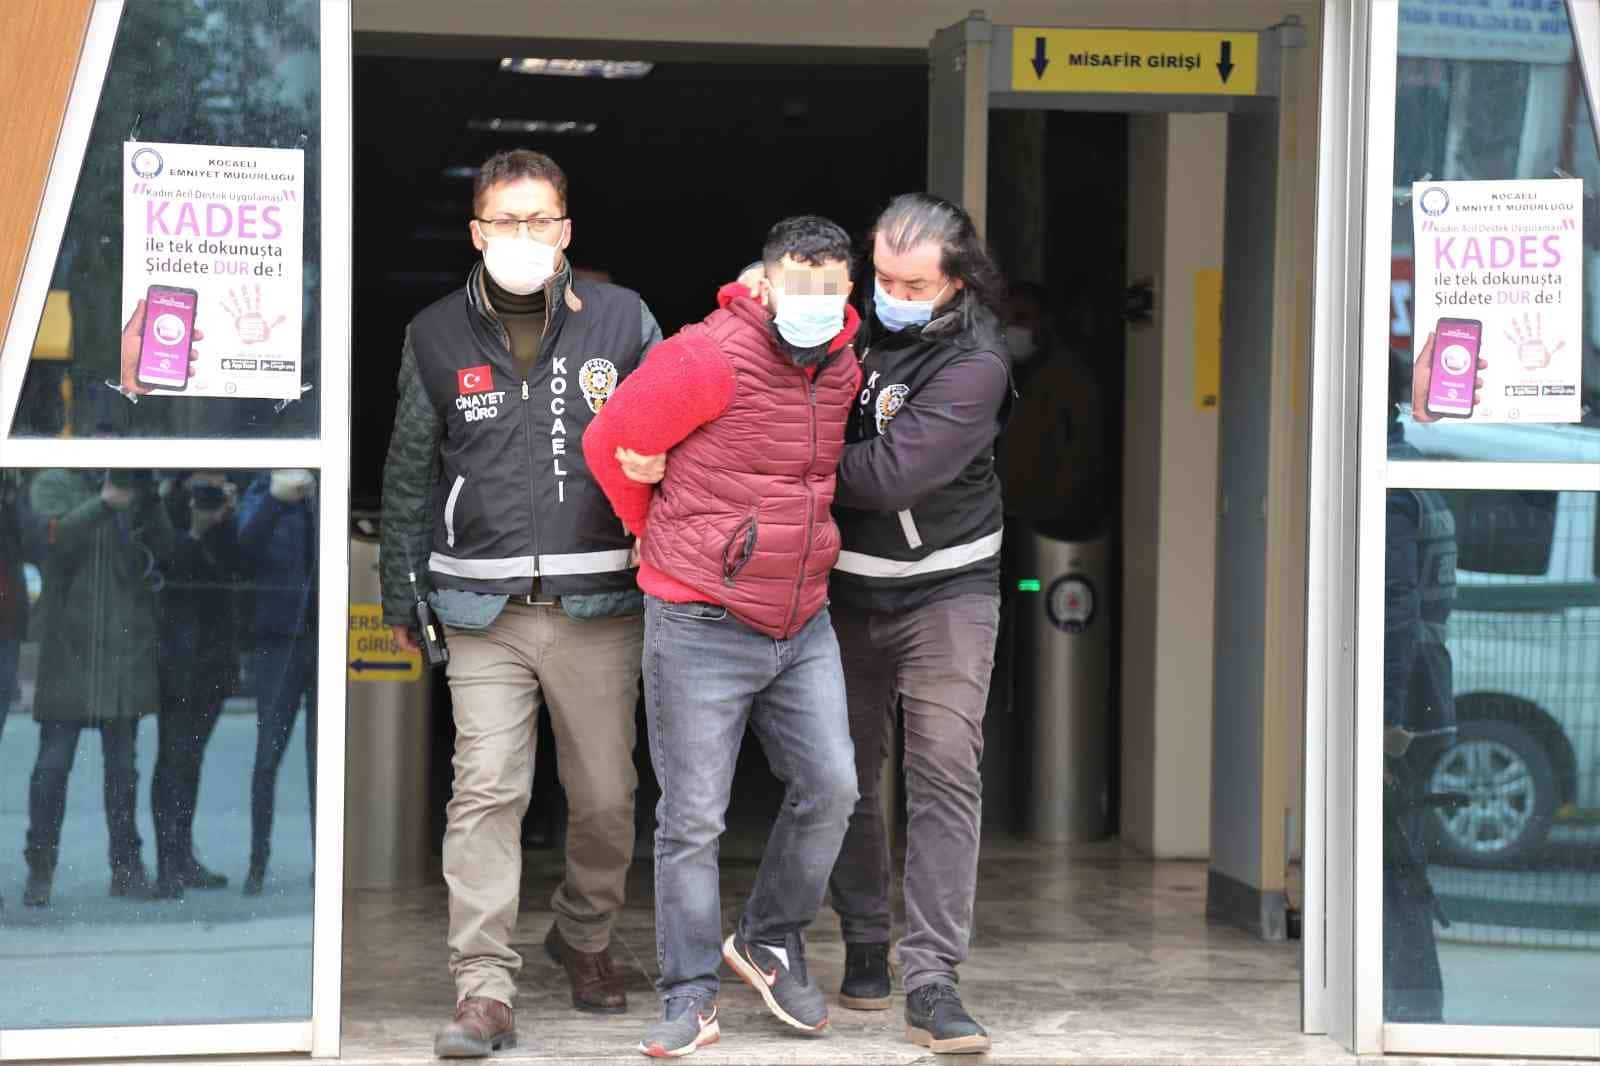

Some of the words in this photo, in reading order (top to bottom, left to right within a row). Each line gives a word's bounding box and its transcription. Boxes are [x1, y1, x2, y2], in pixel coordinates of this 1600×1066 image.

[1068, 51, 1142, 67] MİSAFİR
[1147, 53, 1201, 71] GİRİŞİ
[146, 200, 283, 240] KADES
[145, 237, 164, 252] ile
[169, 239, 193, 253] tek
[198, 240, 283, 259] dokunuşta
[1435, 235, 1562, 269] KADES
[145, 257, 209, 275] Şiddete
[214, 260, 249, 274] DUR
[1434, 272, 1452, 286] ile
[1456, 272, 1478, 286] tek
[1482, 272, 1562, 288] dokunuşta
[1435, 291, 1492, 308] Şiddete
[1497, 291, 1530, 305] DUR
[358, 635, 400, 655] GİRİŞ
